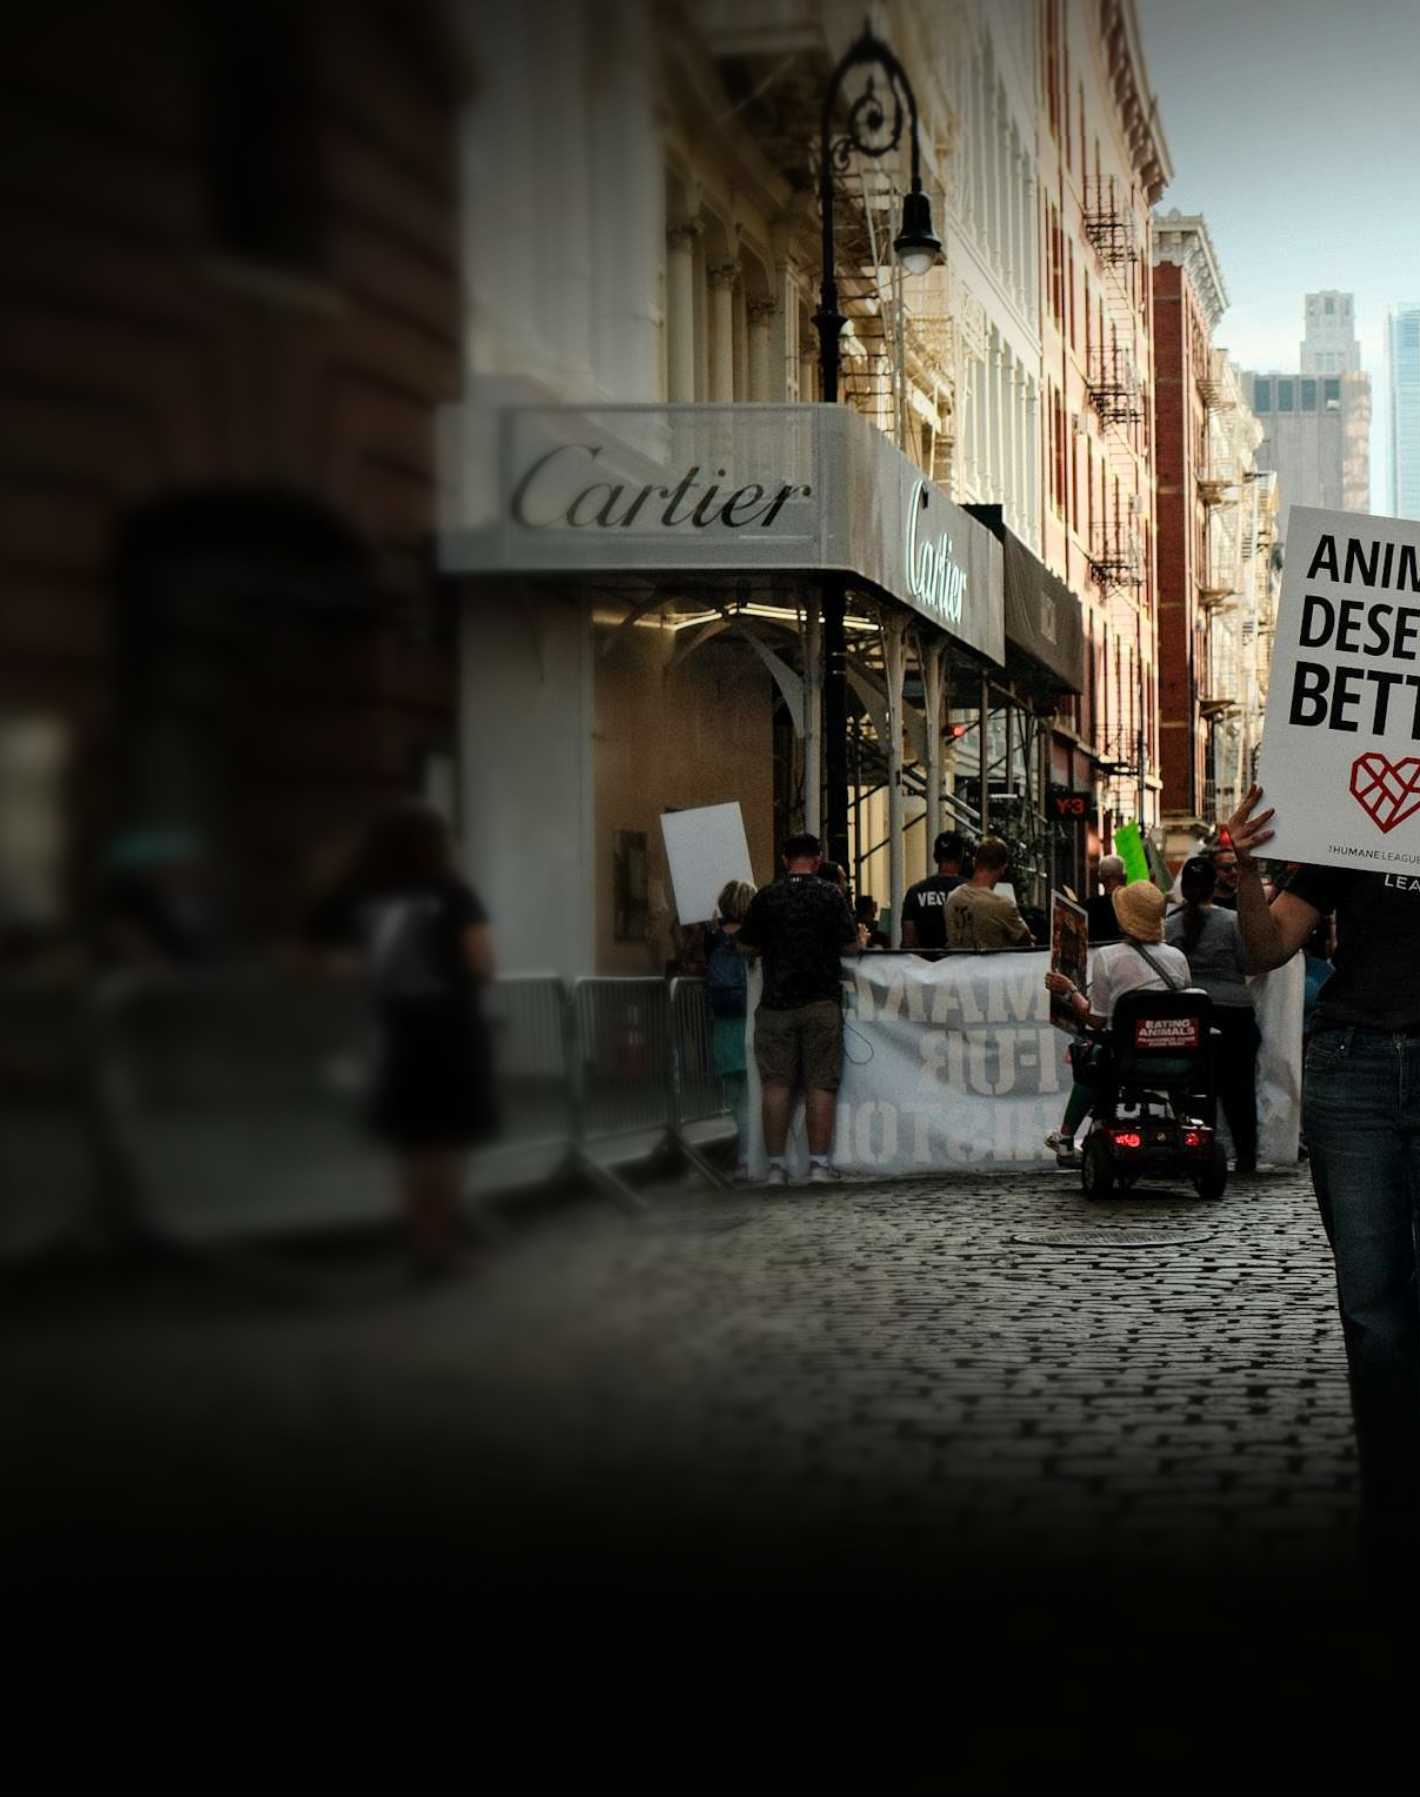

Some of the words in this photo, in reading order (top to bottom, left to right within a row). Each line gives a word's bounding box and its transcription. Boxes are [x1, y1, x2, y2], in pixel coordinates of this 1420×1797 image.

[511, 444, 811, 528] Cartier
[906, 480, 967, 624] Cartier
[1056, 797, 1085, 816] Y-3
[1333, 845, 1380, 860] HUMANE
[1139, 1027, 1197, 1037] ANIMALS
[1145, 1018, 1191, 1029] EATING
